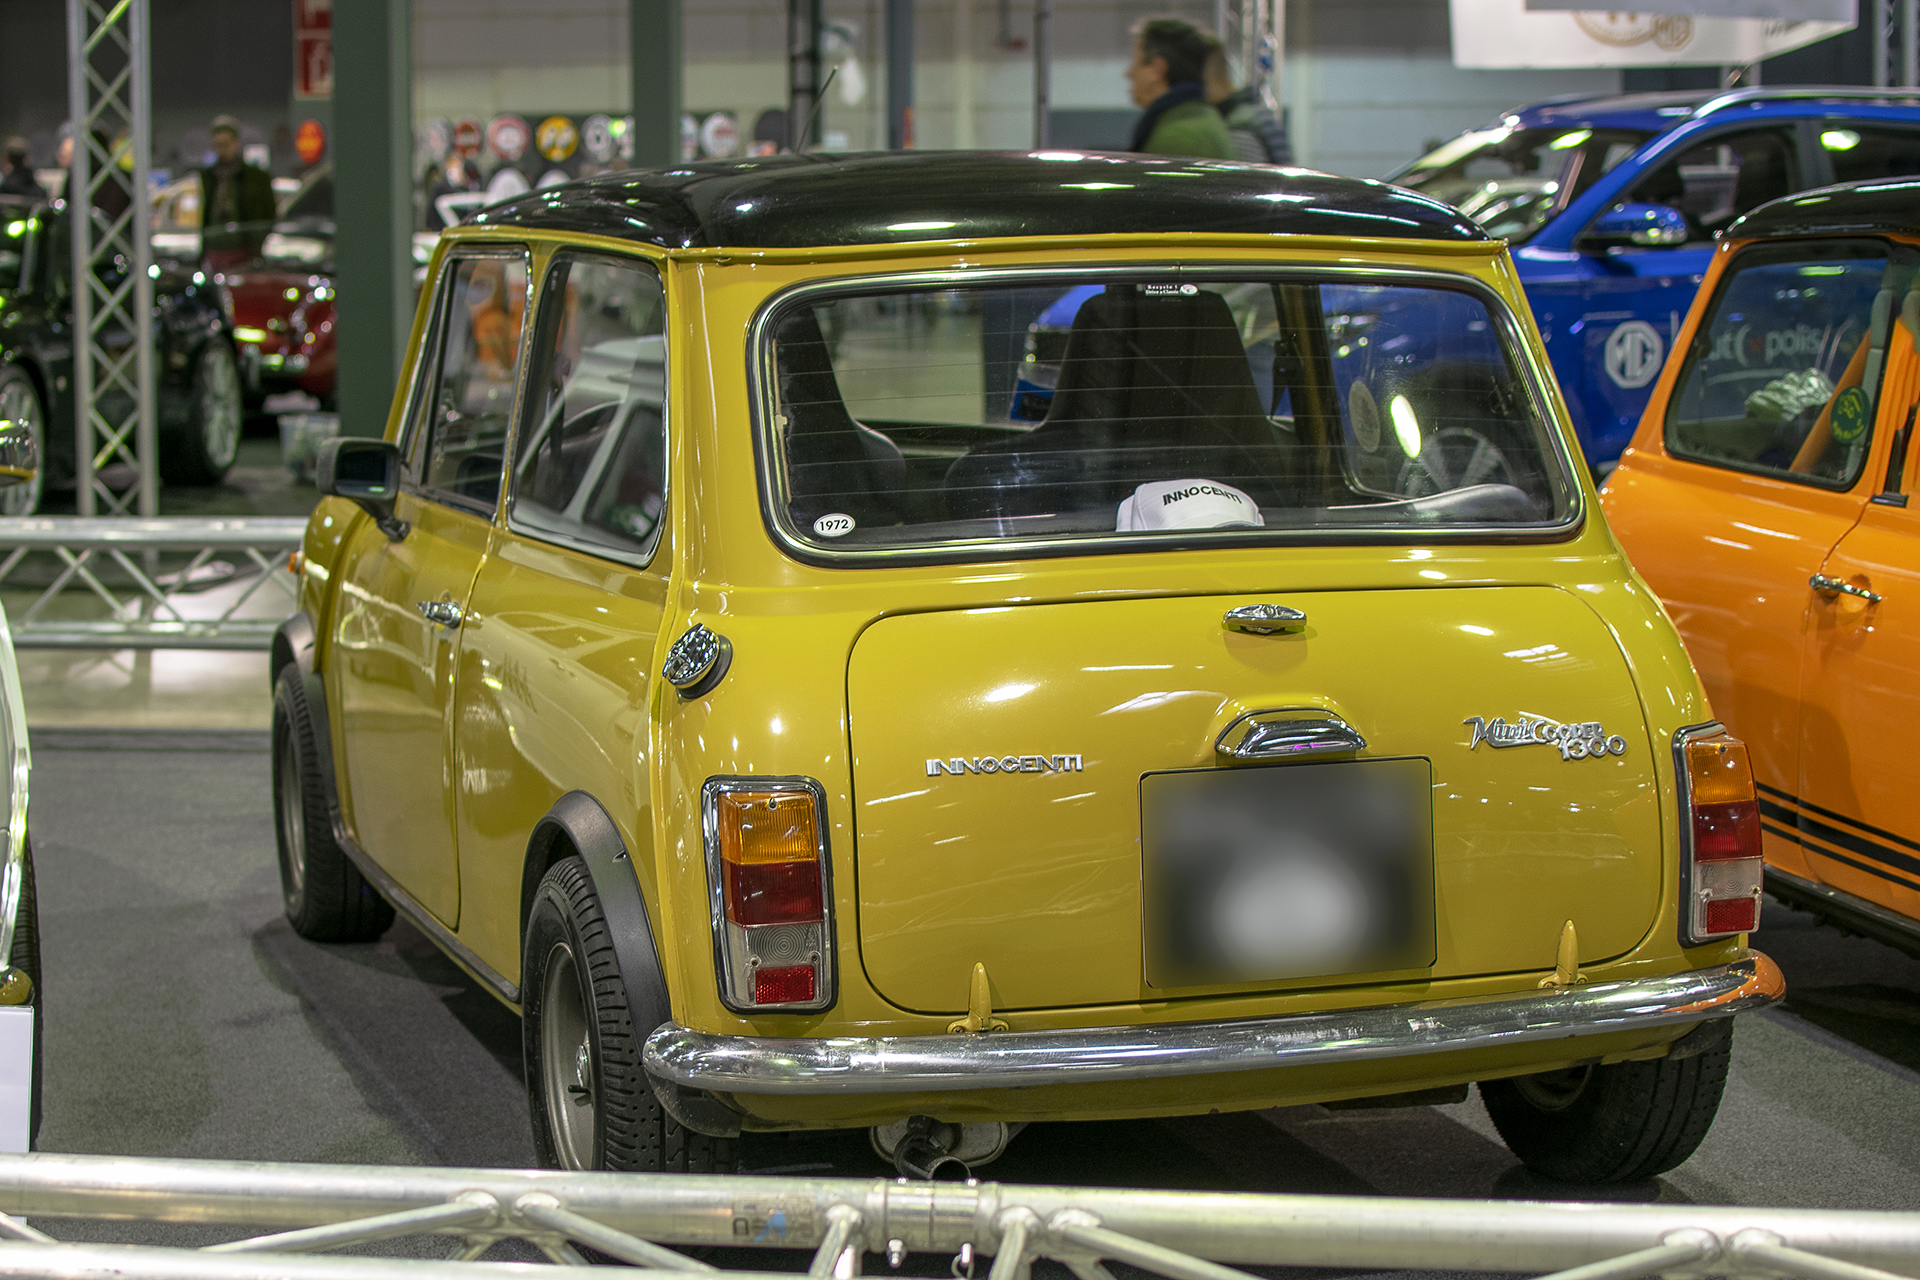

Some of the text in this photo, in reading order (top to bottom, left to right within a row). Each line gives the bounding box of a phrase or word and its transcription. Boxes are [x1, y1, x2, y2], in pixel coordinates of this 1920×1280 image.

[1606, 324, 1661, 385] MG
[1162, 486, 1242, 505] INNOCENTI
[820, 519, 849, 531] 1972
[1463, 715, 1535, 749] Mini
[1558, 734, 1628, 761] 1300
[926, 754, 1082, 776] INNOCENTI
